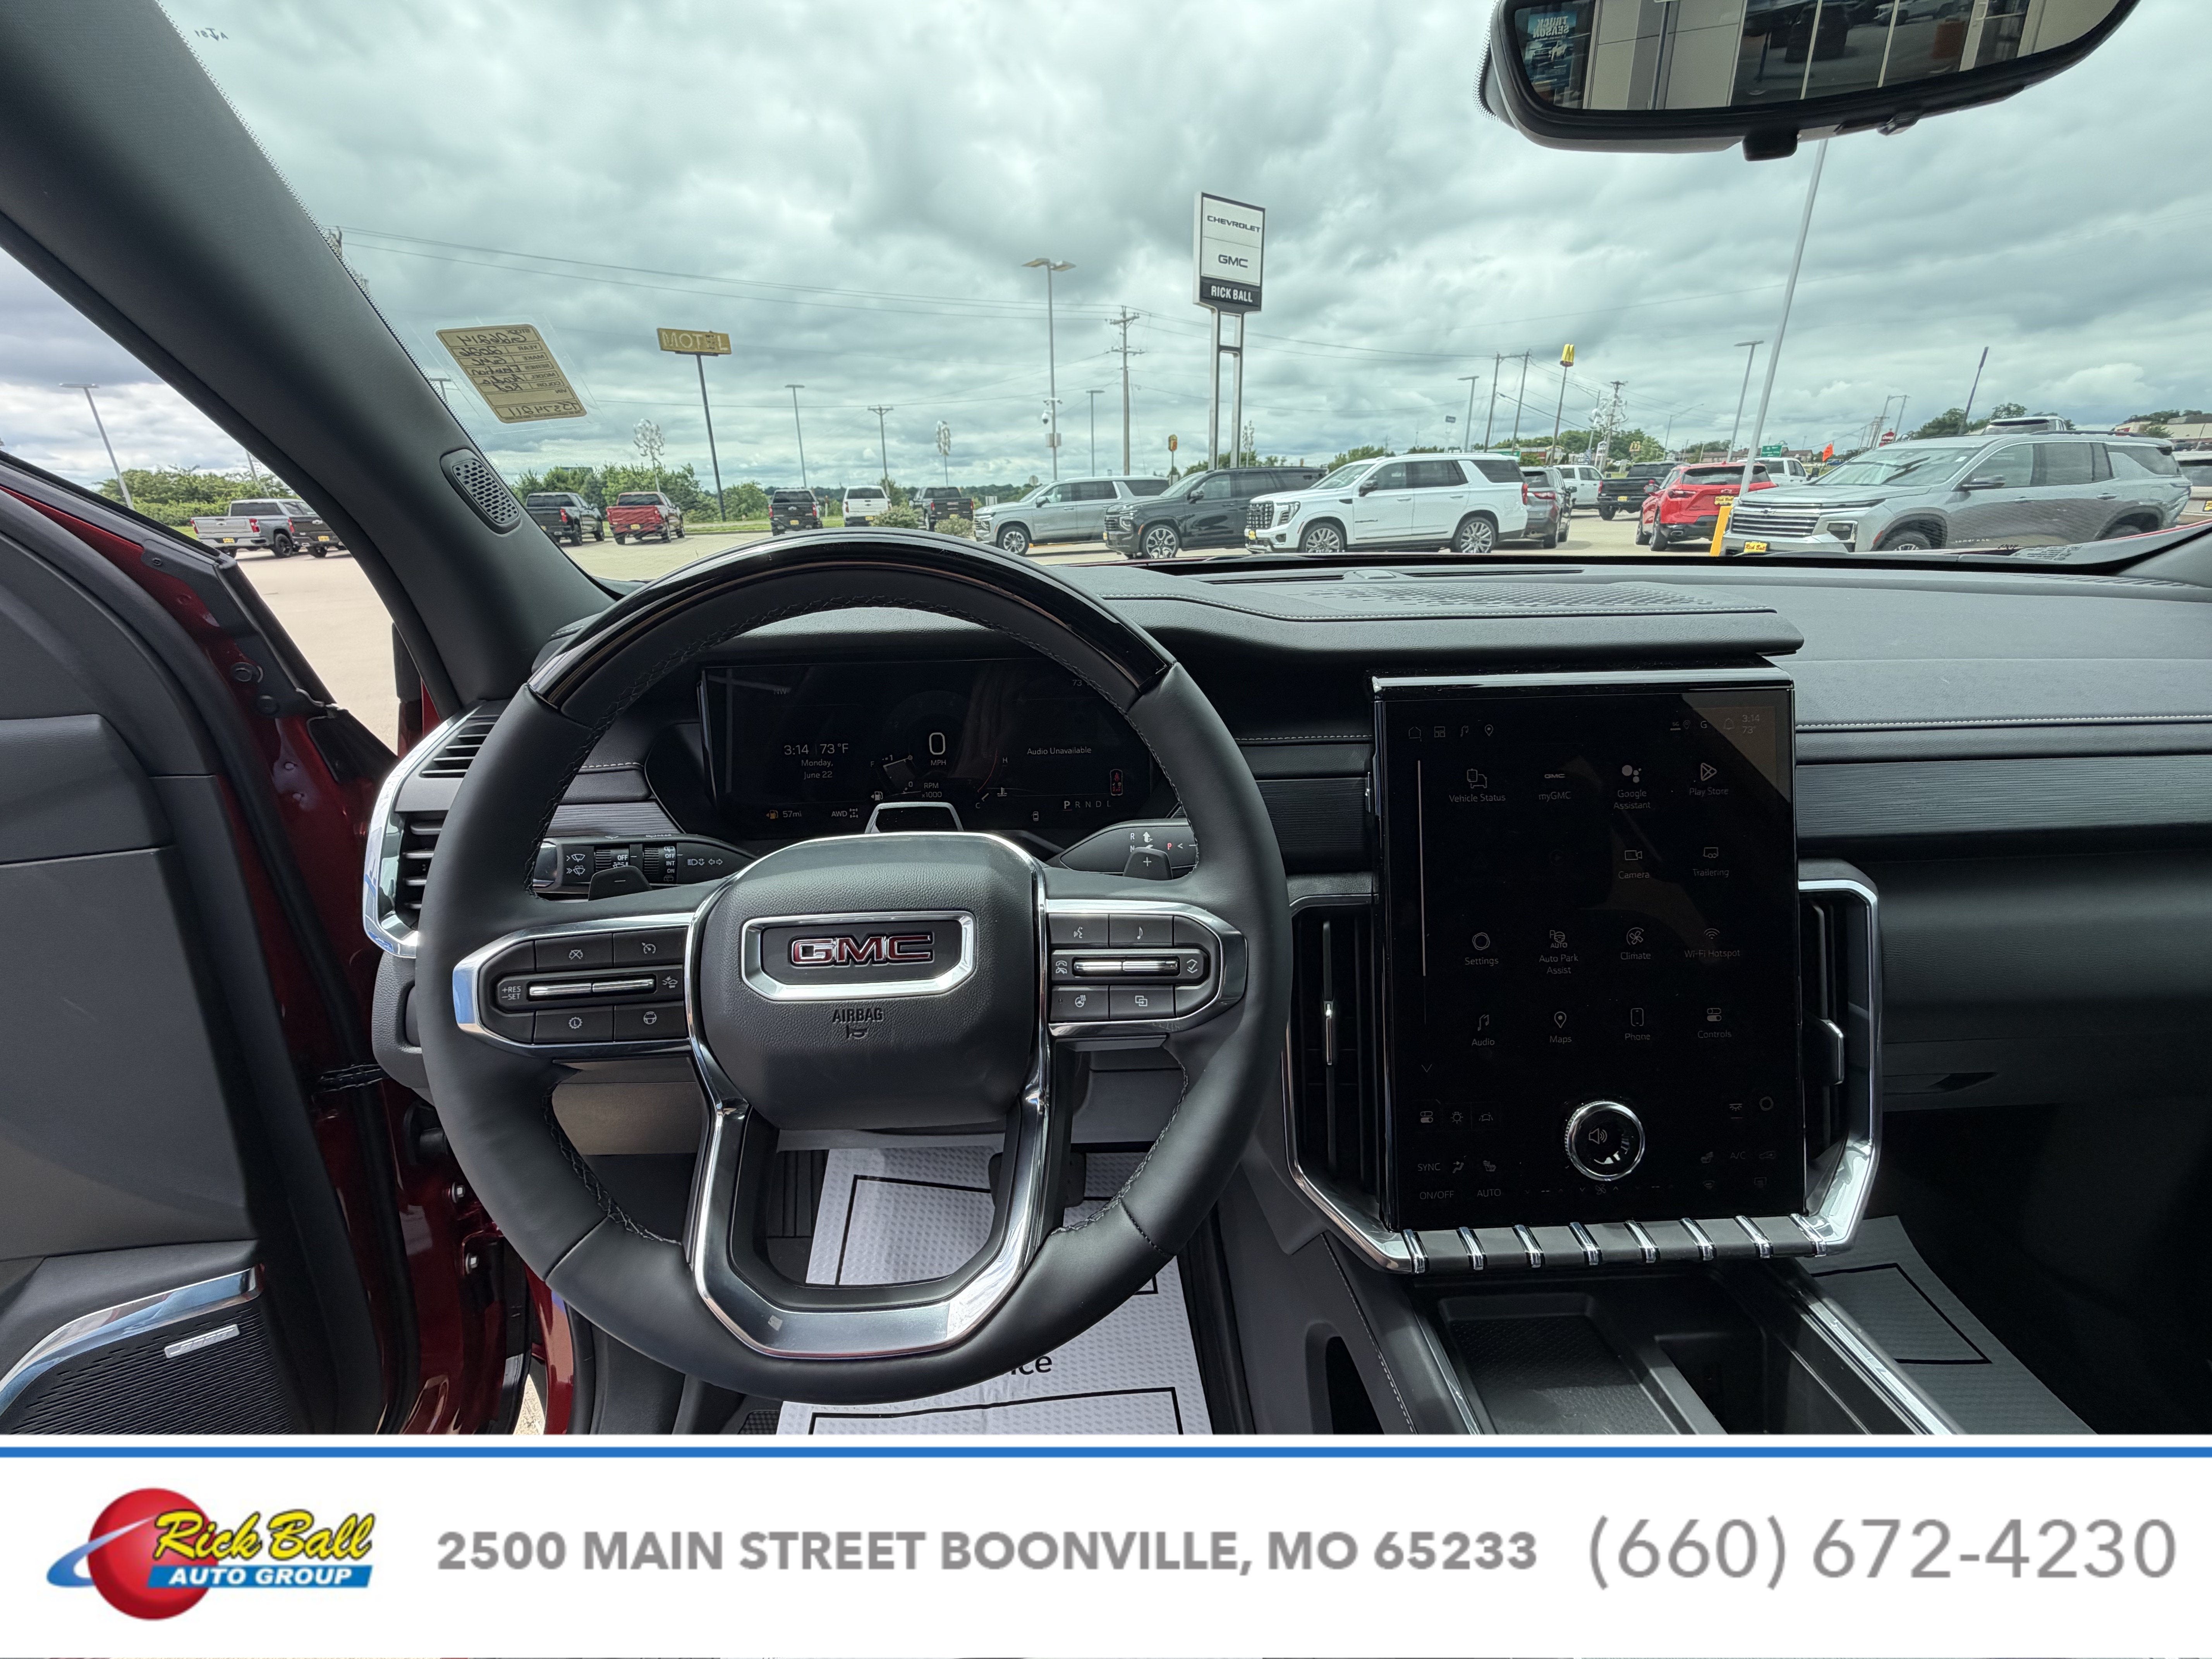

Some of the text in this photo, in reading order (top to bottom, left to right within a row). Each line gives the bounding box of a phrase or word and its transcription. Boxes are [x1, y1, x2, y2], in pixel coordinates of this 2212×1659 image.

[1207, 215, 1261, 233] CHEVROLET
[1218, 254, 1248, 268] GMC
[1211, 285, 1253, 302] RICK BALL
[929, 732, 946, 755] 0
[784, 744, 809, 755] 3:14
[1050, 746, 1092, 754] Unavailable
[1617, 789, 1647, 798] Google
[1689, 788, 1705, 796] Play
[1449, 794, 1478, 803] Vehicle
[1539, 792, 1571, 802] myGMC
[1064, 800, 1070, 809] P
[1693, 869, 1729, 878] Trailering
[791, 934, 932, 964] GMC
[1560, 953, 1578, 962] Park
[1620, 951, 1651, 960] Climate
[1684, 950, 1741, 958] Wi-Fi Hotspot
[1465, 957, 1499, 966] Settings
[832, 1008, 883, 1023] AIRBAG
[1549, 1035, 1572, 1044] Maps
[1625, 1033, 1651, 1041] Phone
[1730, 1151, 1746, 1159] A/C
[1418, 1163, 1441, 1171] SYNC
[1420, 1190, 1454, 1200] ON/OFF
[1477, 1188, 1501, 1197] AUTO
[1011, 1356, 1052, 1375] ce
